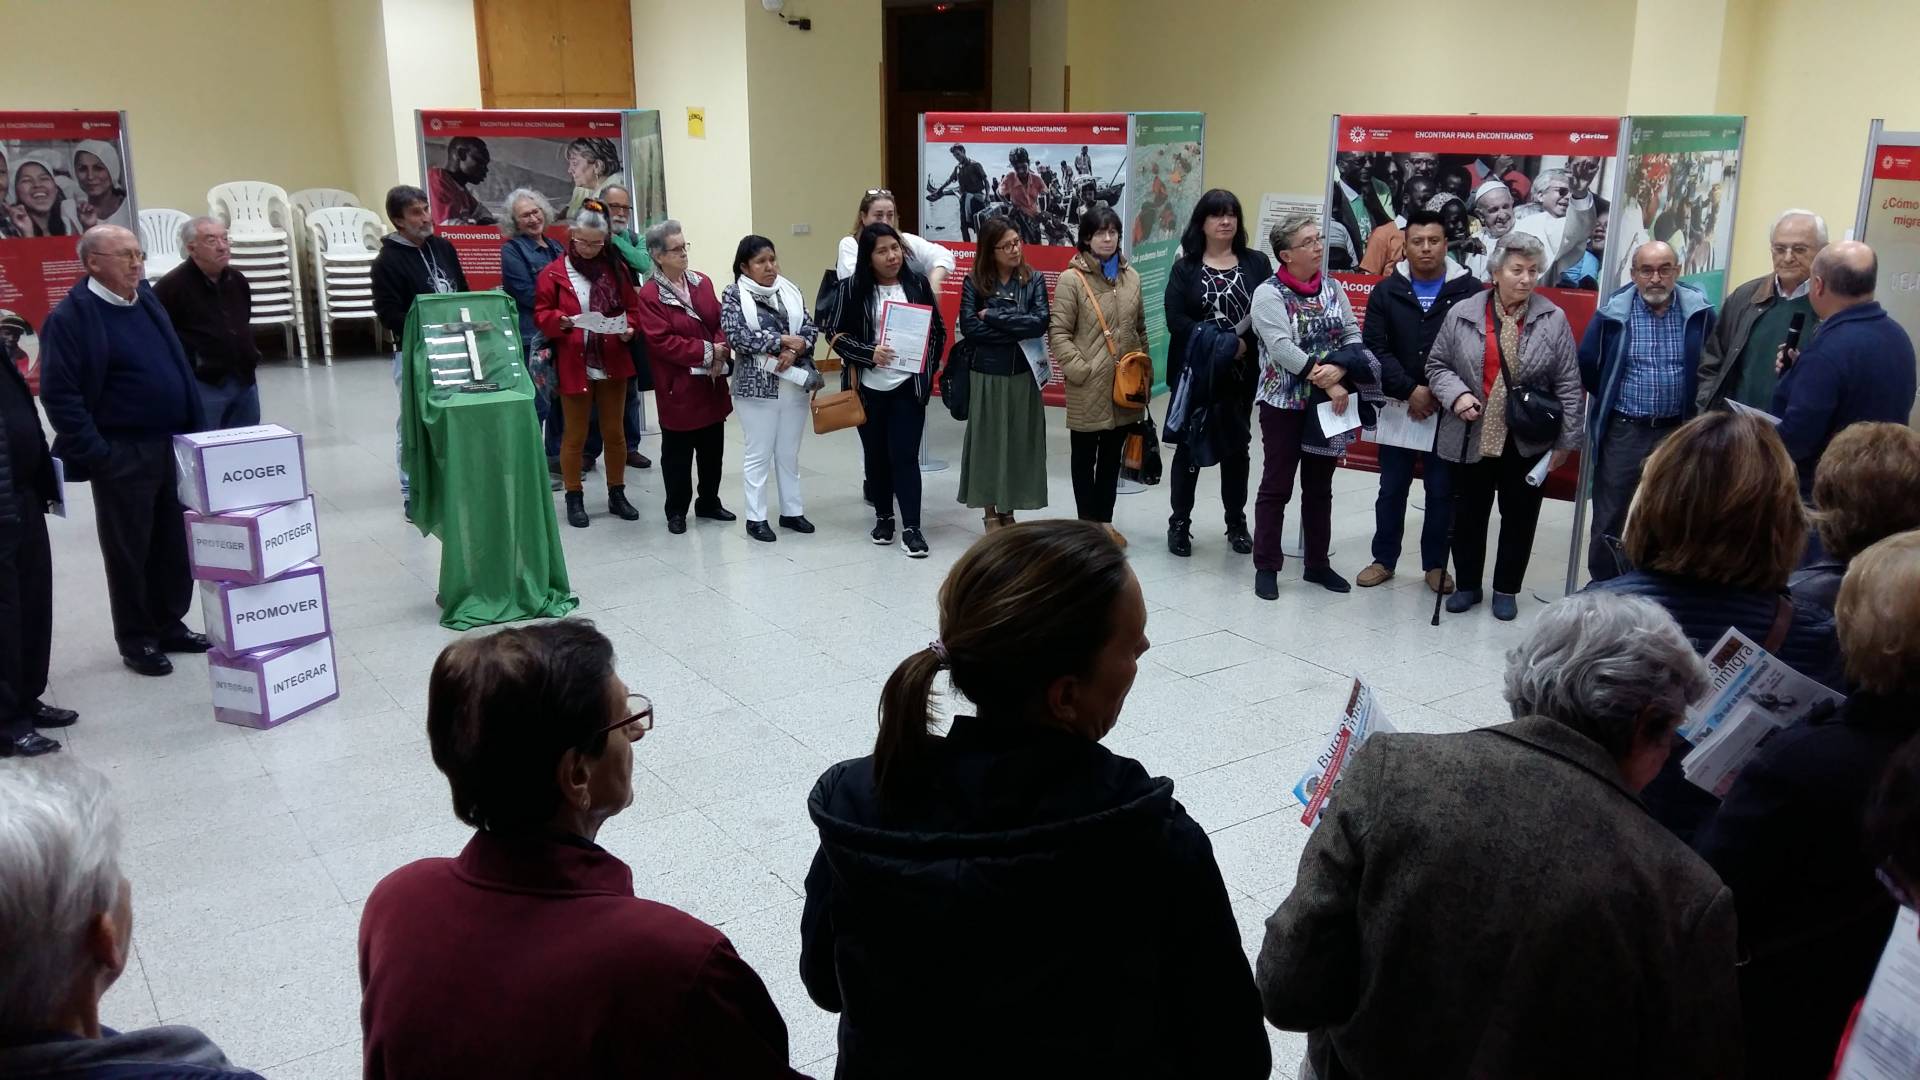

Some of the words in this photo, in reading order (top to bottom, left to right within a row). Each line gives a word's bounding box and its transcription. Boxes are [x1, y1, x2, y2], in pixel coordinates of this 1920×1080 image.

[1476, 132, 1534, 140] ENCONTRARNOS
[1882, 196, 1919, 210] ¿Cómo
[441, 232, 500, 240] Promovemos
[222, 464, 286, 483] ACOGER
[196, 538, 245, 550] PROTEGER
[264, 522, 312, 551] PROTEGER
[236, 600, 318, 624] PROMOVER
[273, 664, 328, 694] INTEGRAR
